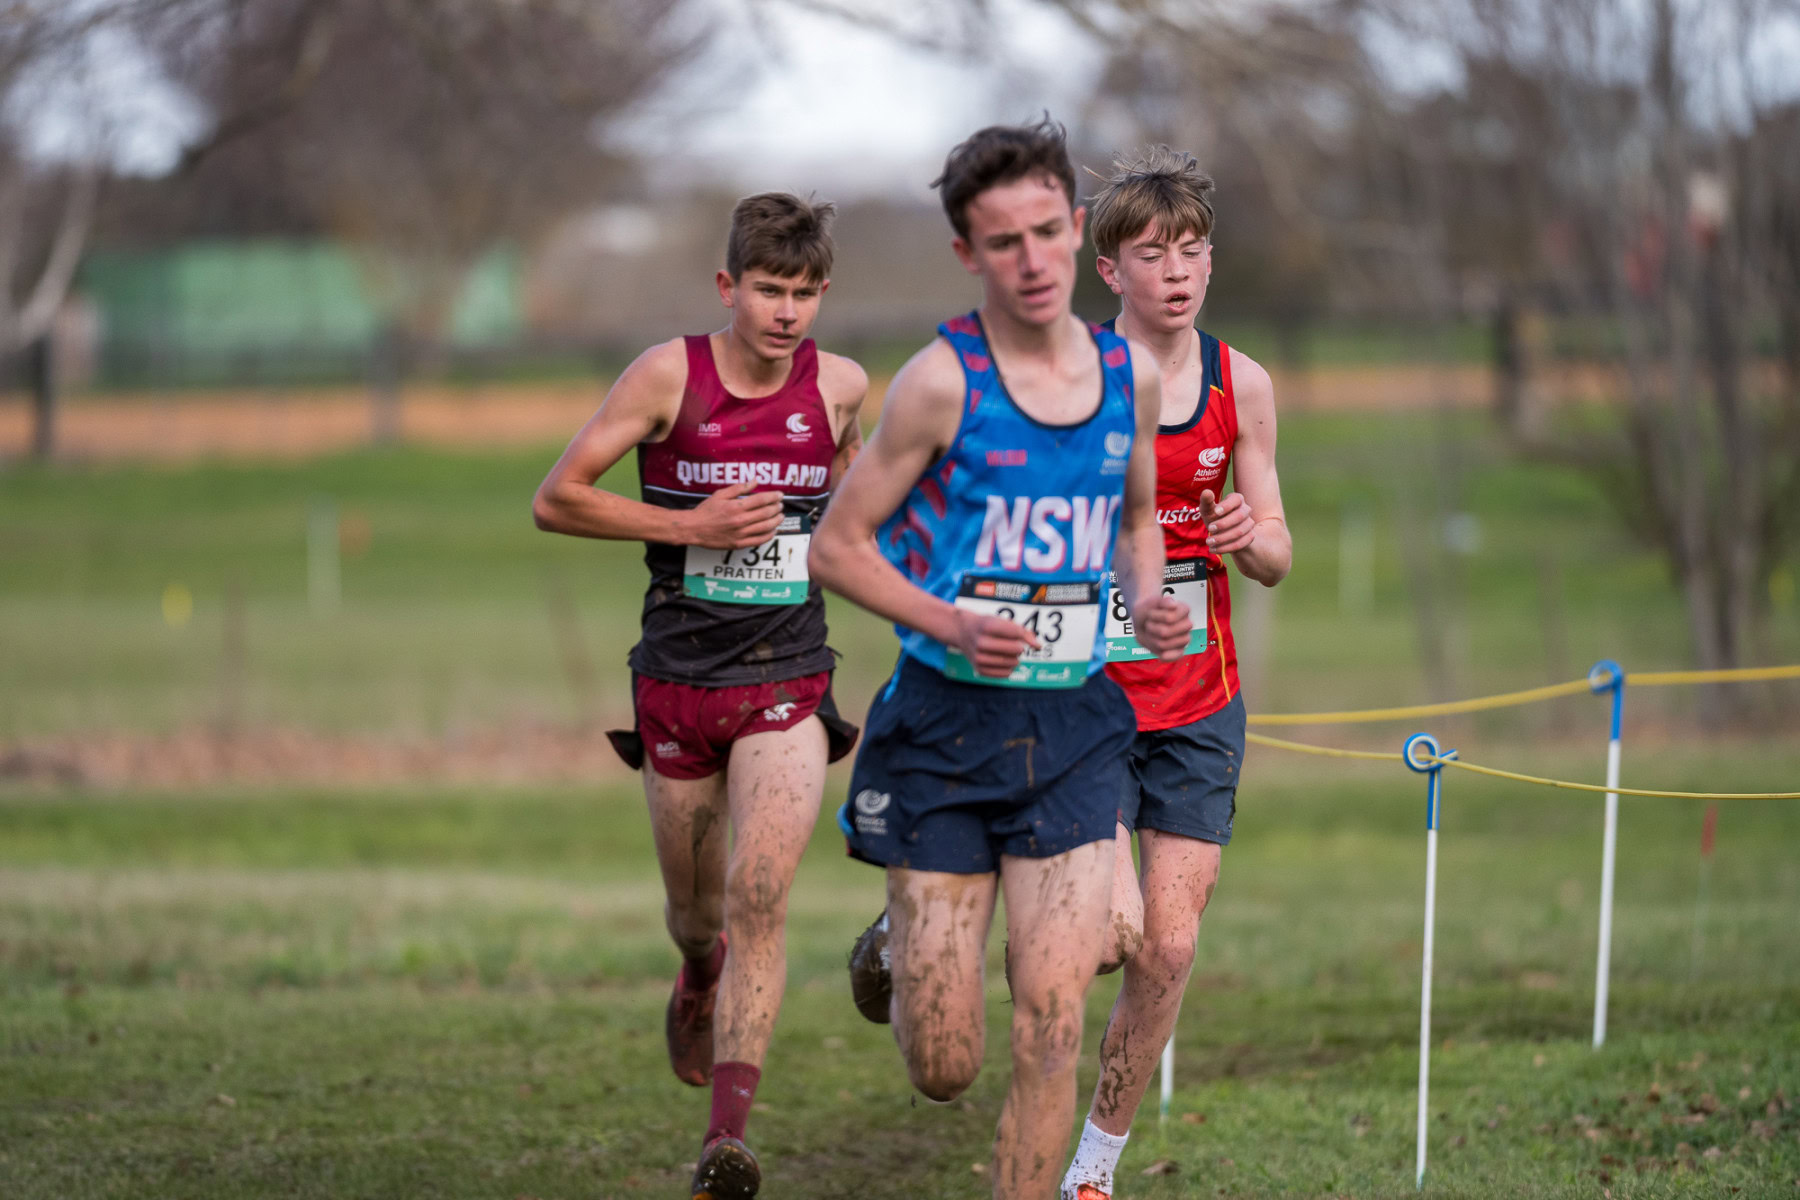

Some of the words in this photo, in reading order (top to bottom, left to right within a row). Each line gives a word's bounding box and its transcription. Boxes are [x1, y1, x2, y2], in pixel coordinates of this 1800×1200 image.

[676, 460, 828, 488] QUEENSLAND
[1156, 505, 1202, 525] ustra
[974, 495, 1123, 573] NSW
[713, 565, 784, 580] PRATTEN
